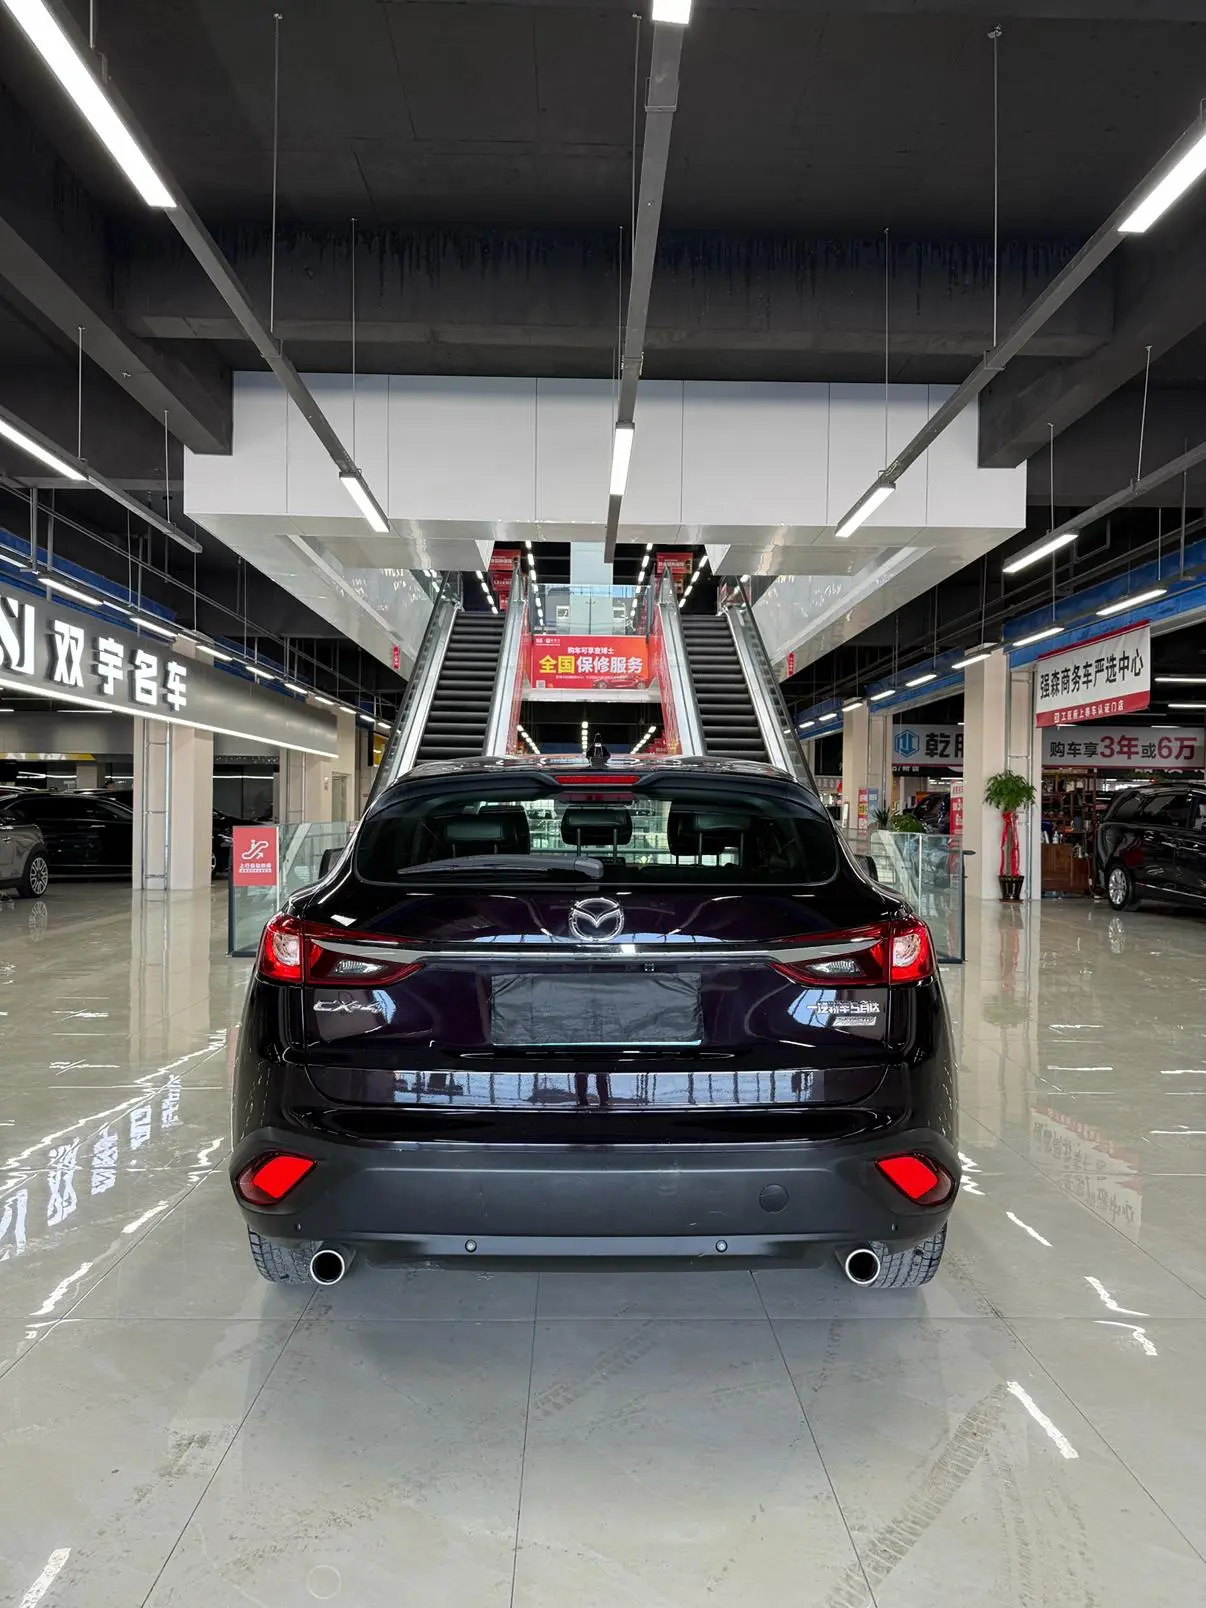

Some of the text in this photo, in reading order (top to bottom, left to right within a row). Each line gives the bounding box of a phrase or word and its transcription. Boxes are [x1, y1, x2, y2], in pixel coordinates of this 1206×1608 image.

[54, 620, 187, 711] 双宇名车
[539, 655, 643, 674] 全国保修服务
[1040, 648, 1144, 699] 强森商务车严选中心
[1049, 735, 1198, 760] 购车享3年或6万
[313, 1000, 384, 1014] CX-4
